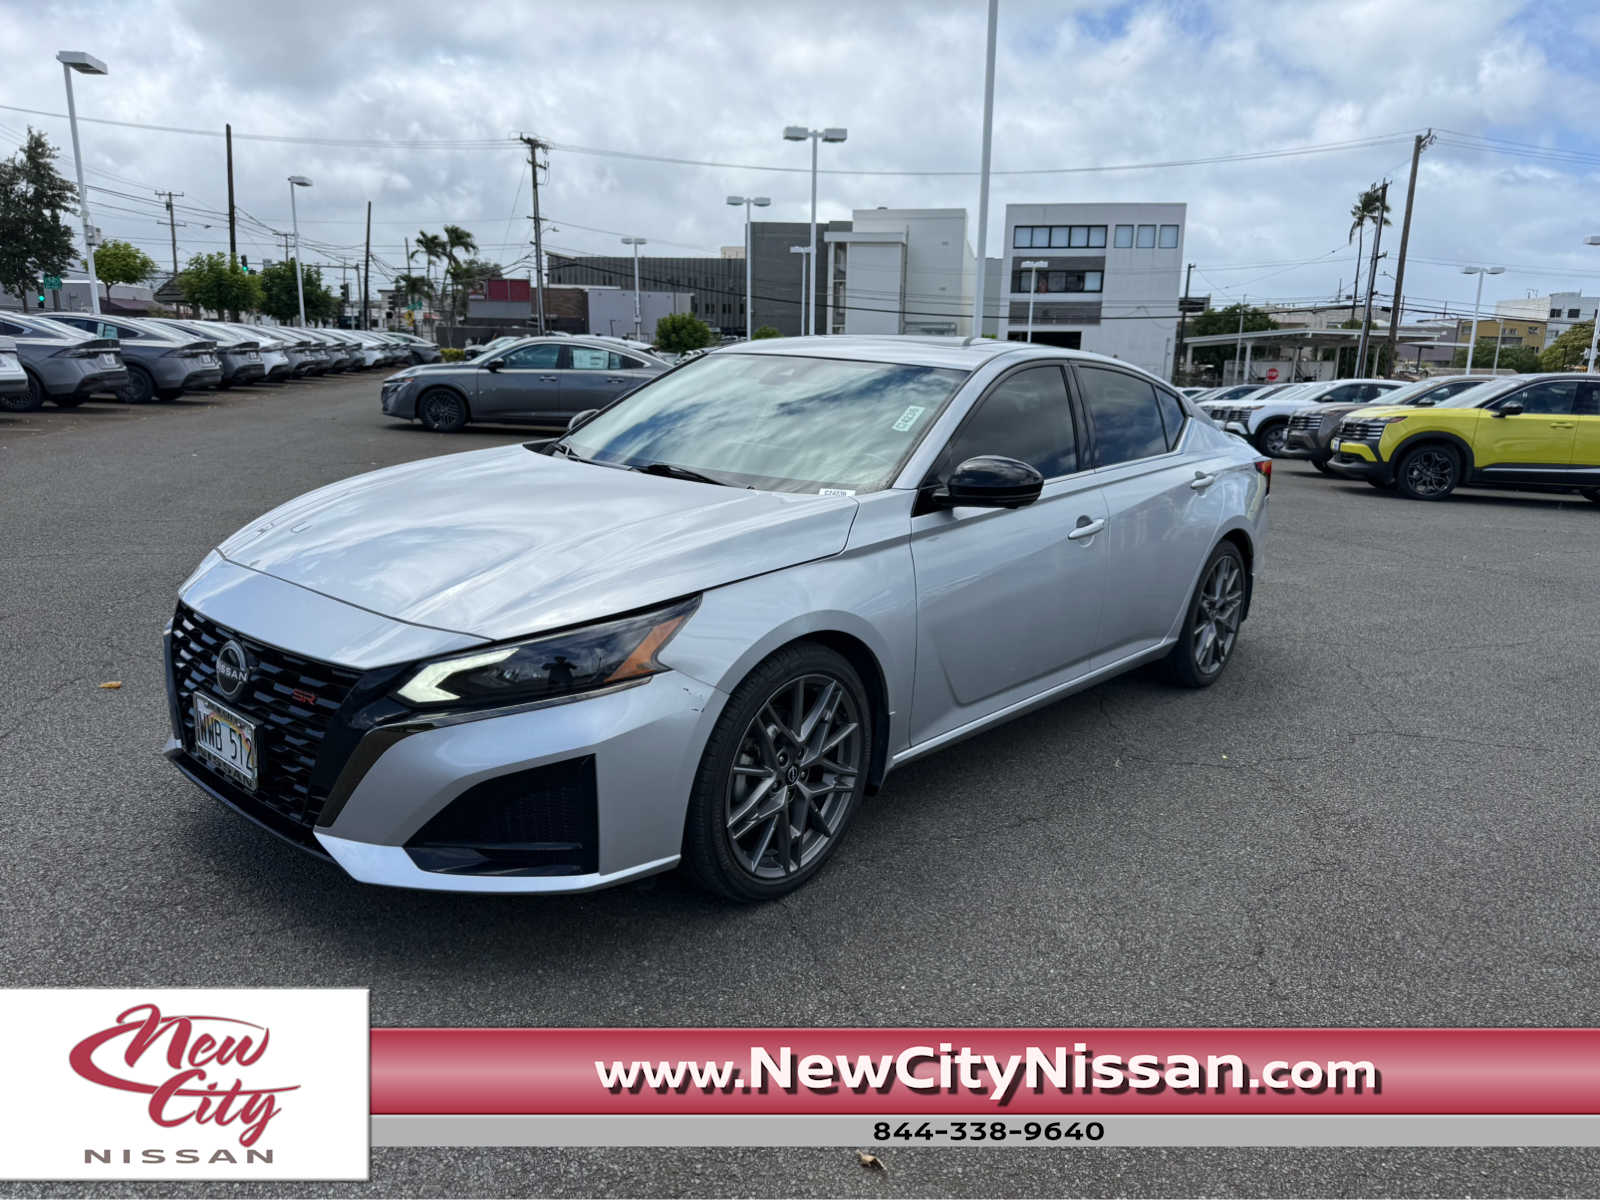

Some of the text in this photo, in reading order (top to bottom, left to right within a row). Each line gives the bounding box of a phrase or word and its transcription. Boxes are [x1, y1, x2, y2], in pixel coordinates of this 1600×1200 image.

[216, 661, 248, 682] NISSAN
[292, 688, 316, 705] SR
[229, 727, 253, 771] 512
